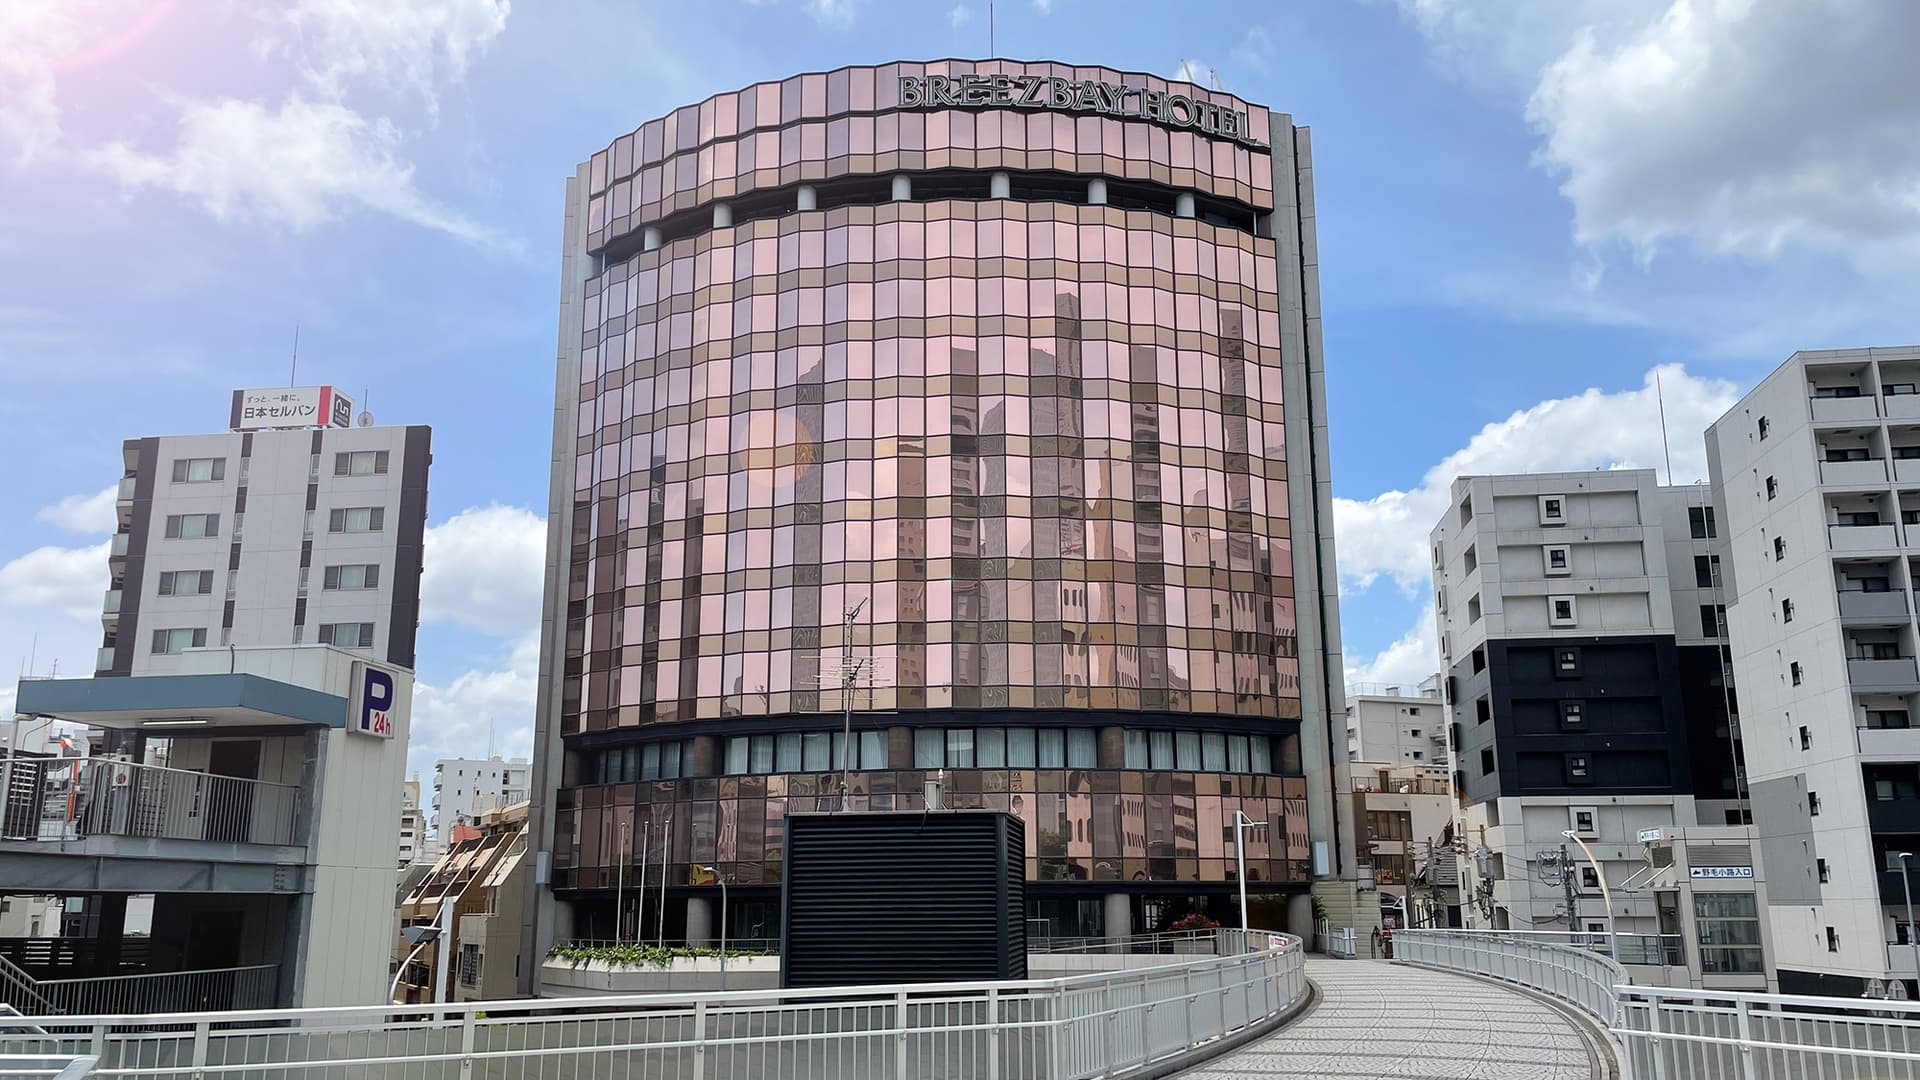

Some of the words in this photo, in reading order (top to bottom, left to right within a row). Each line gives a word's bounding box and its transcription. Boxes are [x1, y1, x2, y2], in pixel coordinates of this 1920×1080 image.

[898, 74, 1127, 114] BREEZBAY
[1140, 88, 1257, 146] HOTEL
[244, 404, 316, 419] 日本セルバン
[361, 667, 393, 730] P
[373, 711, 391, 736] 24h
[1702, 867, 1751, 877] 野毛小路入口
